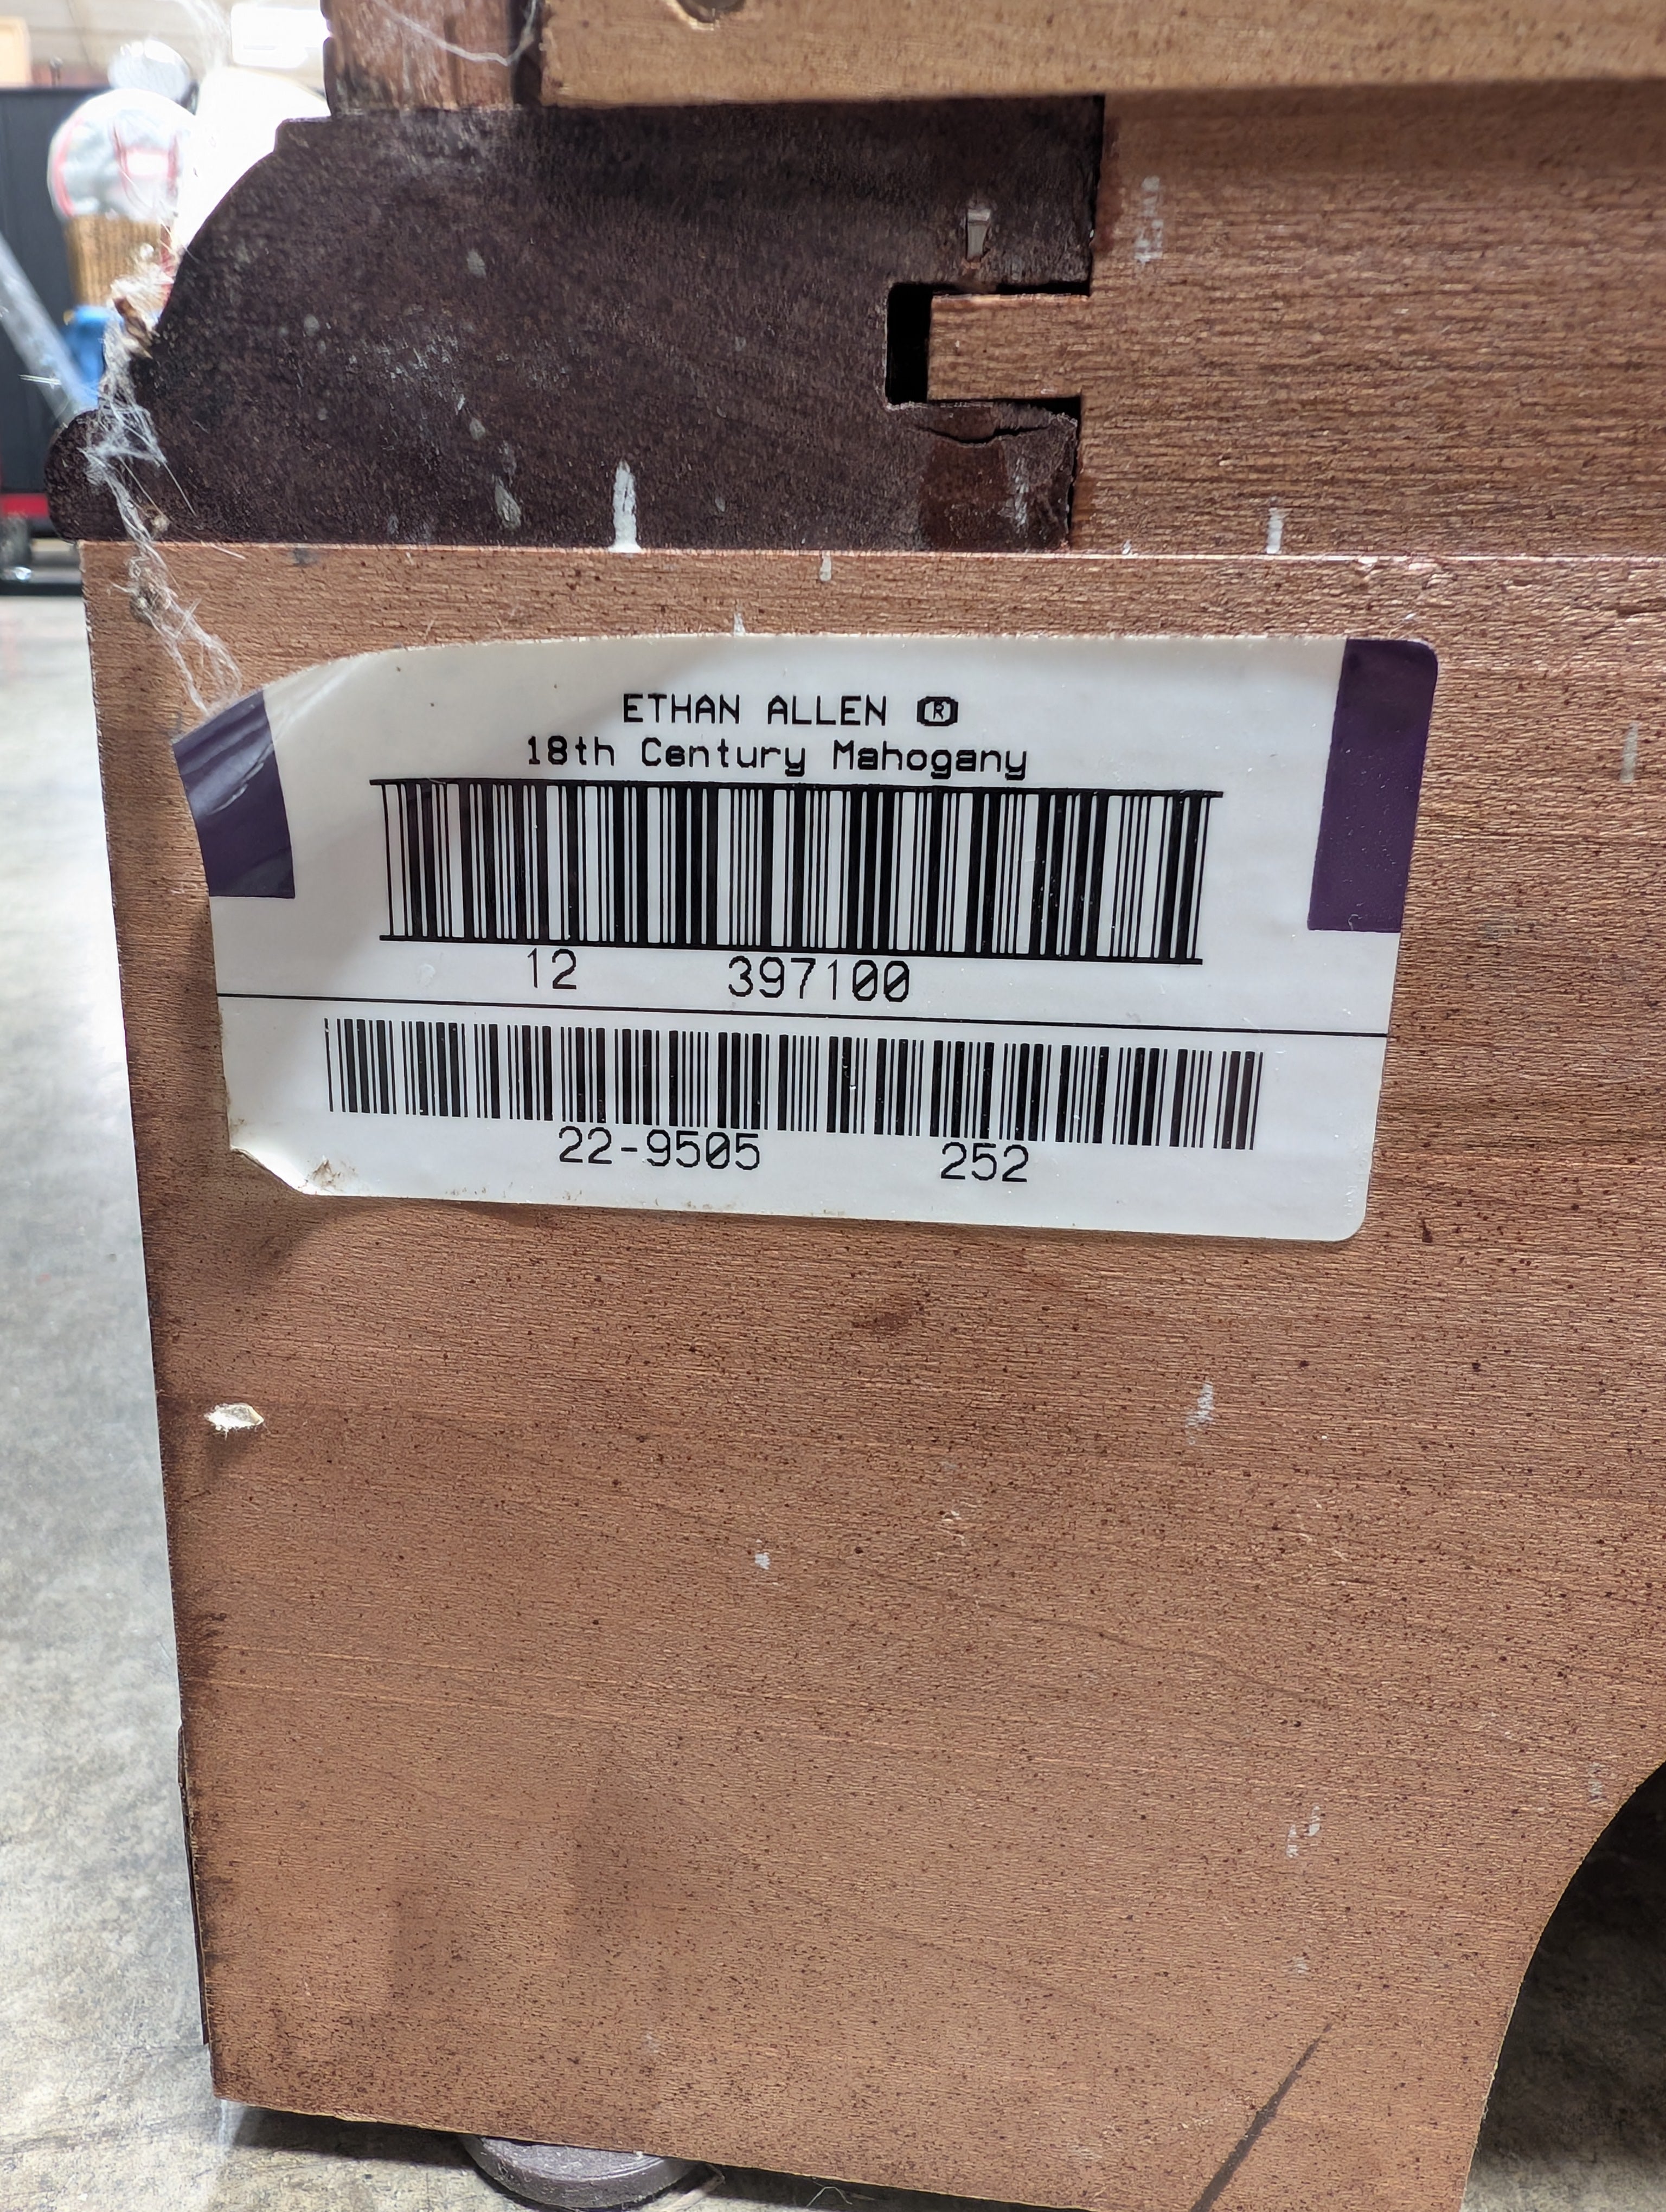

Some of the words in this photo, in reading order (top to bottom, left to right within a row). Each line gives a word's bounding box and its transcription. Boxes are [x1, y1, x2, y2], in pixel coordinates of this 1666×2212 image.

[623, 692, 740, 724] ETHAN
[767, 695, 887, 726] ALLEN
[527, 735, 616, 767] 18th
[642, 737, 805, 777] Century
[833, 740, 1027, 781] Mahogany
[527, 949, 578, 991] 12
[728, 956, 911, 1003] 397100
[559, 1126, 760, 1171] 22-9505
[940, 1142, 1029, 1182] 252
